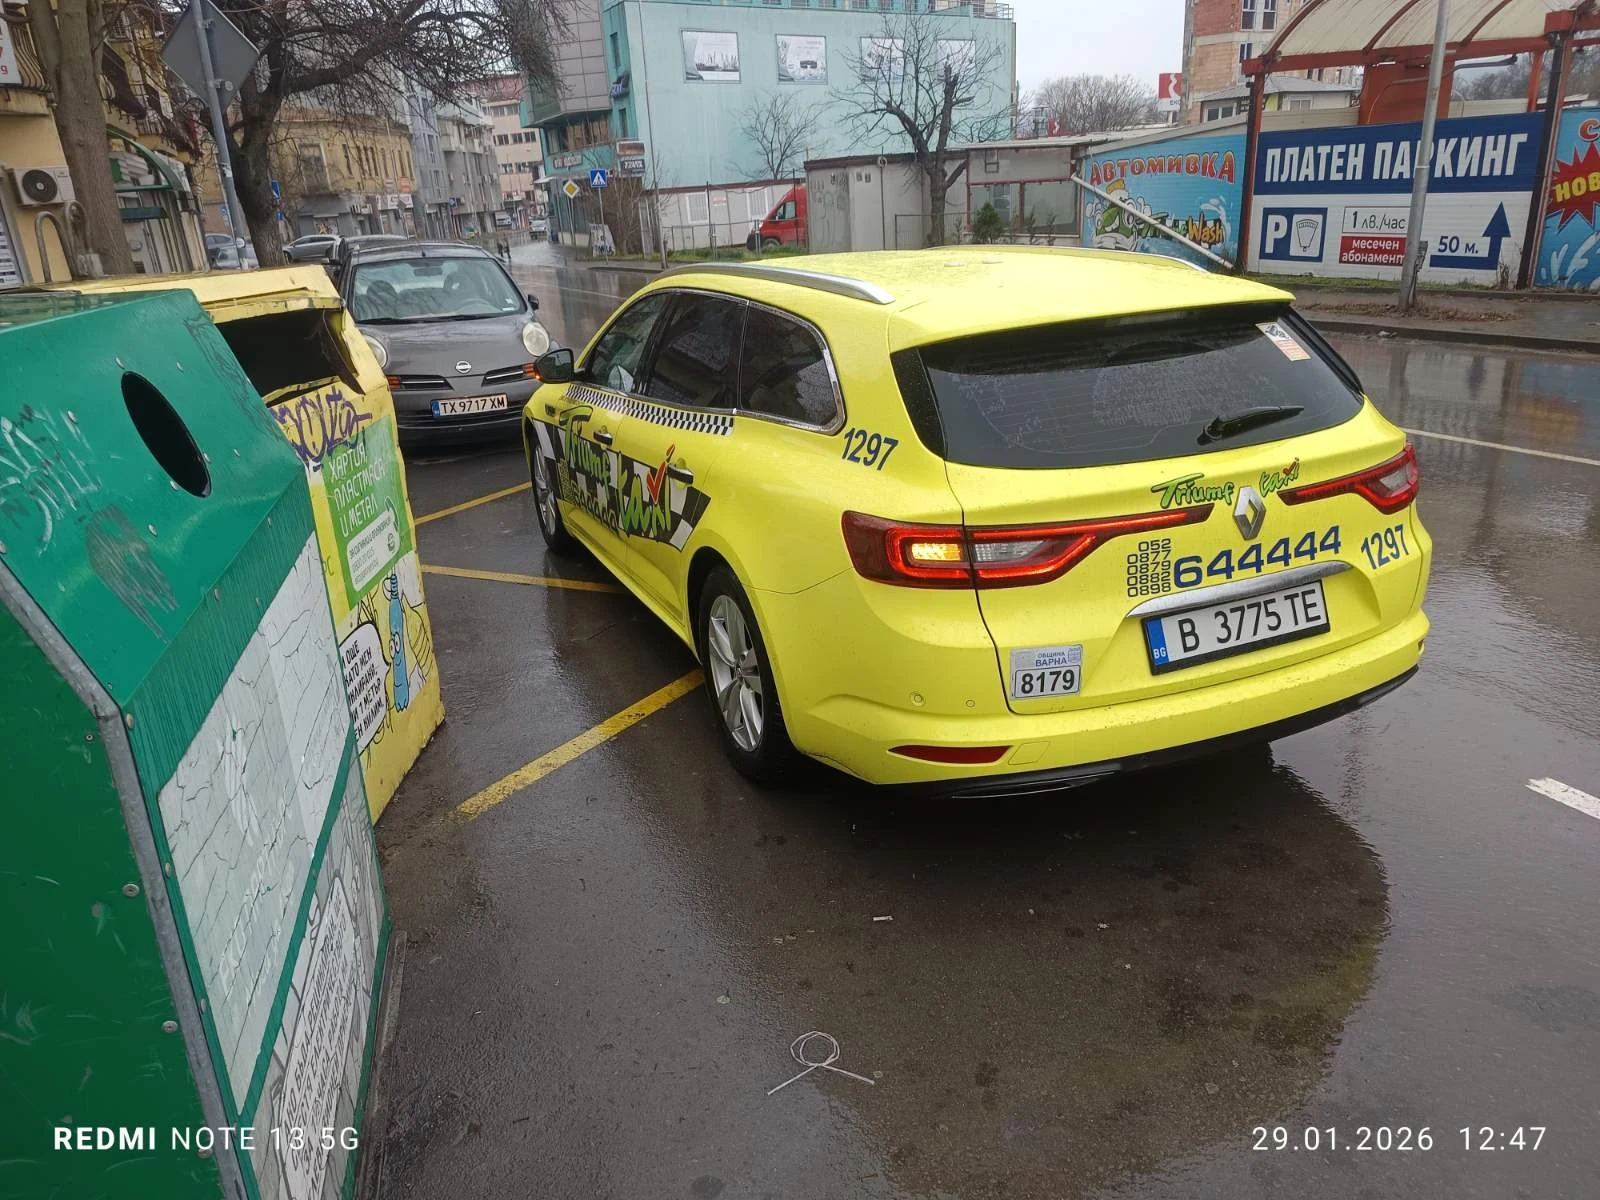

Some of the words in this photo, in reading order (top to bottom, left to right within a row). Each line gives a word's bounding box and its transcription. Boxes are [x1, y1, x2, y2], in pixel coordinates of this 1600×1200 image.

[1089, 150, 1236, 186] АВТОМИВКА
[1264, 143, 1365, 183] ПЛАТЕН
[1187, 211, 1225, 243] Wash
[1352, 210, 1358, 229] 1
[1352, 239, 1400, 251] месечен
[1438, 235, 1459, 253] 50
[1464, 241, 1479, 254] м.
[441, 402, 457, 414] TX
[459, 398, 486, 412] 9717
[490, 396, 505, 409] XM
[842, 427, 899, 471] 1297
[1151, 472, 1234, 508] Triumf
[1259, 459, 1300, 497] taxi
[1138, 538, 1171, 552] 052
[1361, 524, 1409, 569] 1297
[1127, 549, 1171, 565] 0877
[1173, 525, 1341, 589] 644444
[1127, 560, 1171, 575] 0879
[1127, 571, 1171, 586] 0882
[1127, 582, 1171, 597] 0898
[1178, 618, 1200, 653] B
[1214, 598, 1282, 644] 3775
[1284, 589, 1321, 626] TE
[1035, 658, 1068, 667] ВАРНА
[1153, 648, 1167, 659] BG
[1021, 669, 1075, 694] 8179
